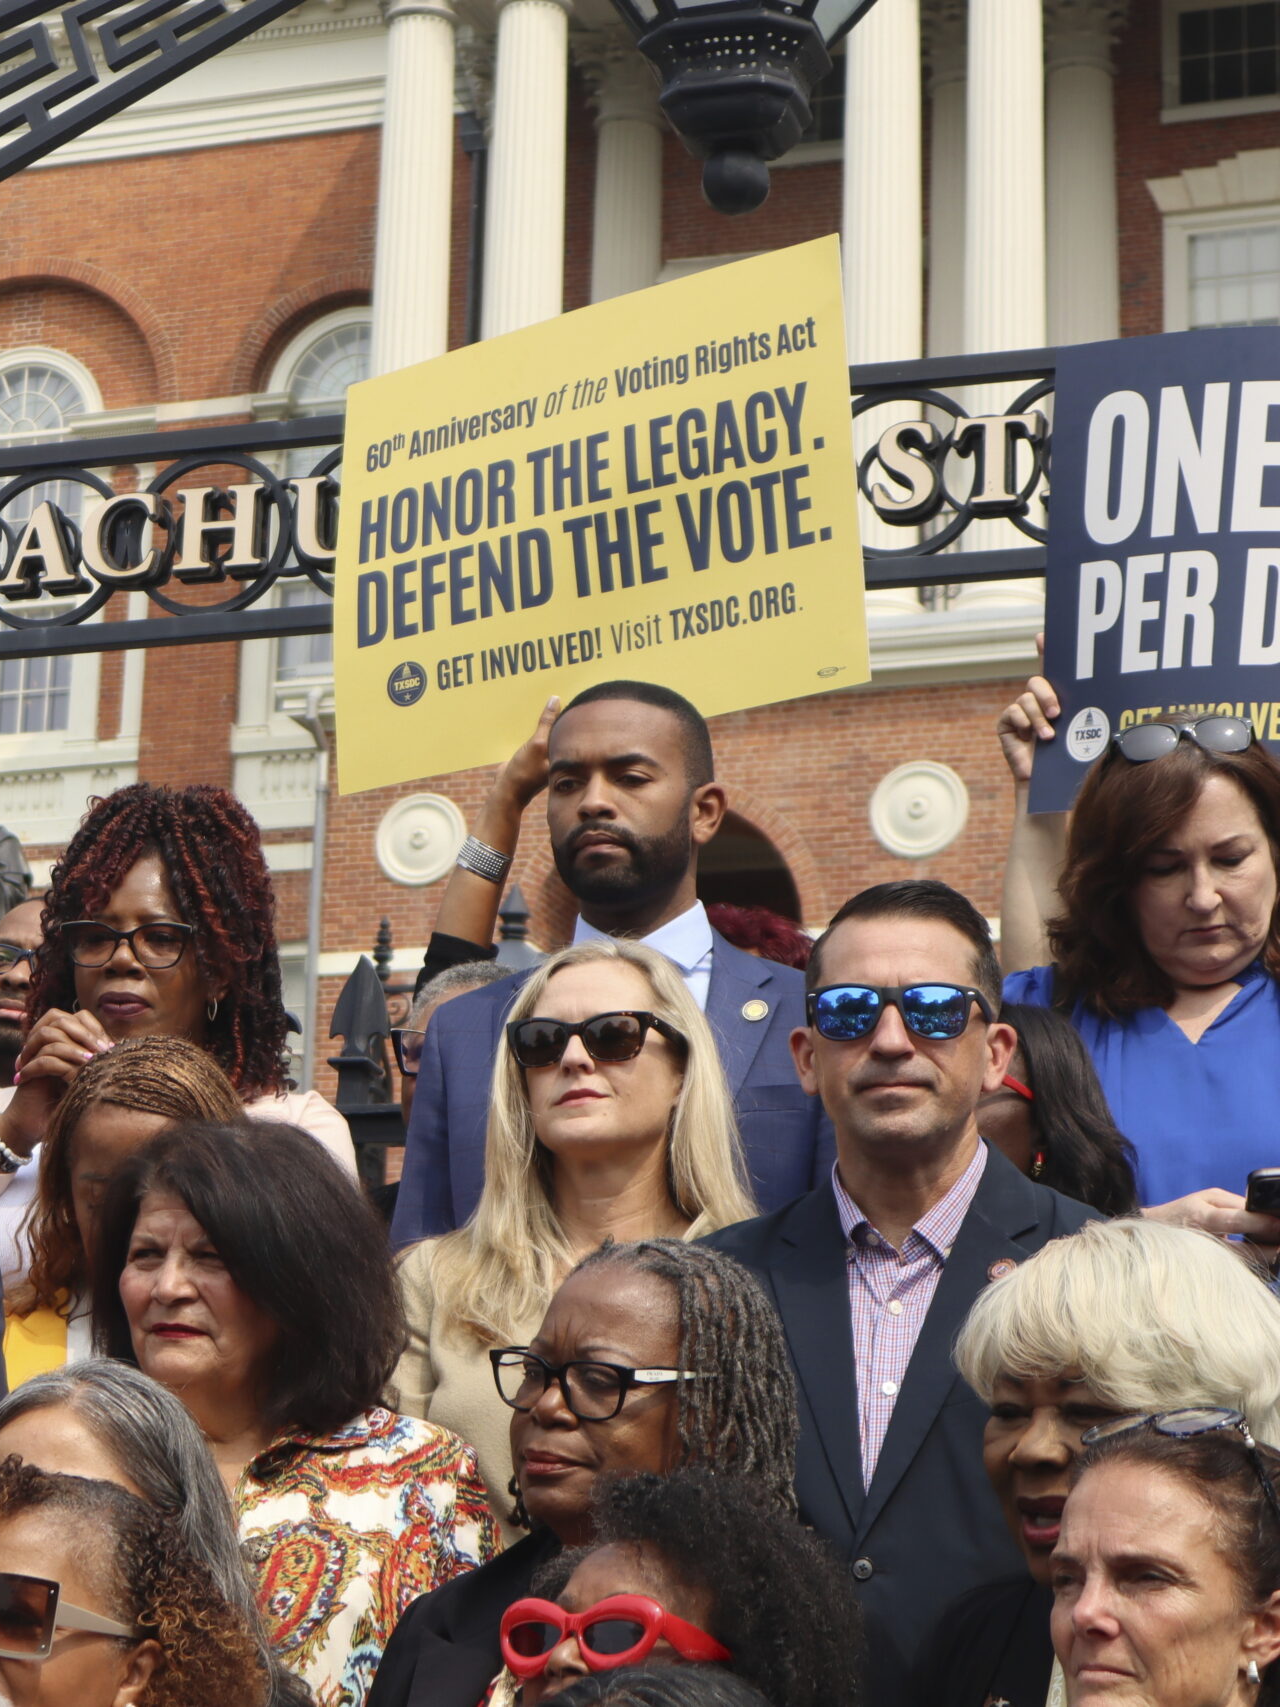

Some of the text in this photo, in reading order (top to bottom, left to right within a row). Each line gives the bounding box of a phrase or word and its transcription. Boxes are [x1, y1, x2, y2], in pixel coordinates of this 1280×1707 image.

[366, 317, 817, 472] 60th Anniversary of the Voting Rights Act
[358, 381, 826, 565] HONOR THE LEGACY.
[871, 411, 1050, 511] ST
[1084, 380, 1280, 545] ONE
[357, 464, 833, 649] DEFEND THE VOTE.
[1075, 549, 1219, 680] PER
[394, 677, 421, 692] TXSDC
[437, 653, 475, 691] GET
[480, 627, 603, 681] INVOLVED!
[610, 614, 663, 654] Visit
[1075, 728, 1102, 741] TXSDC
